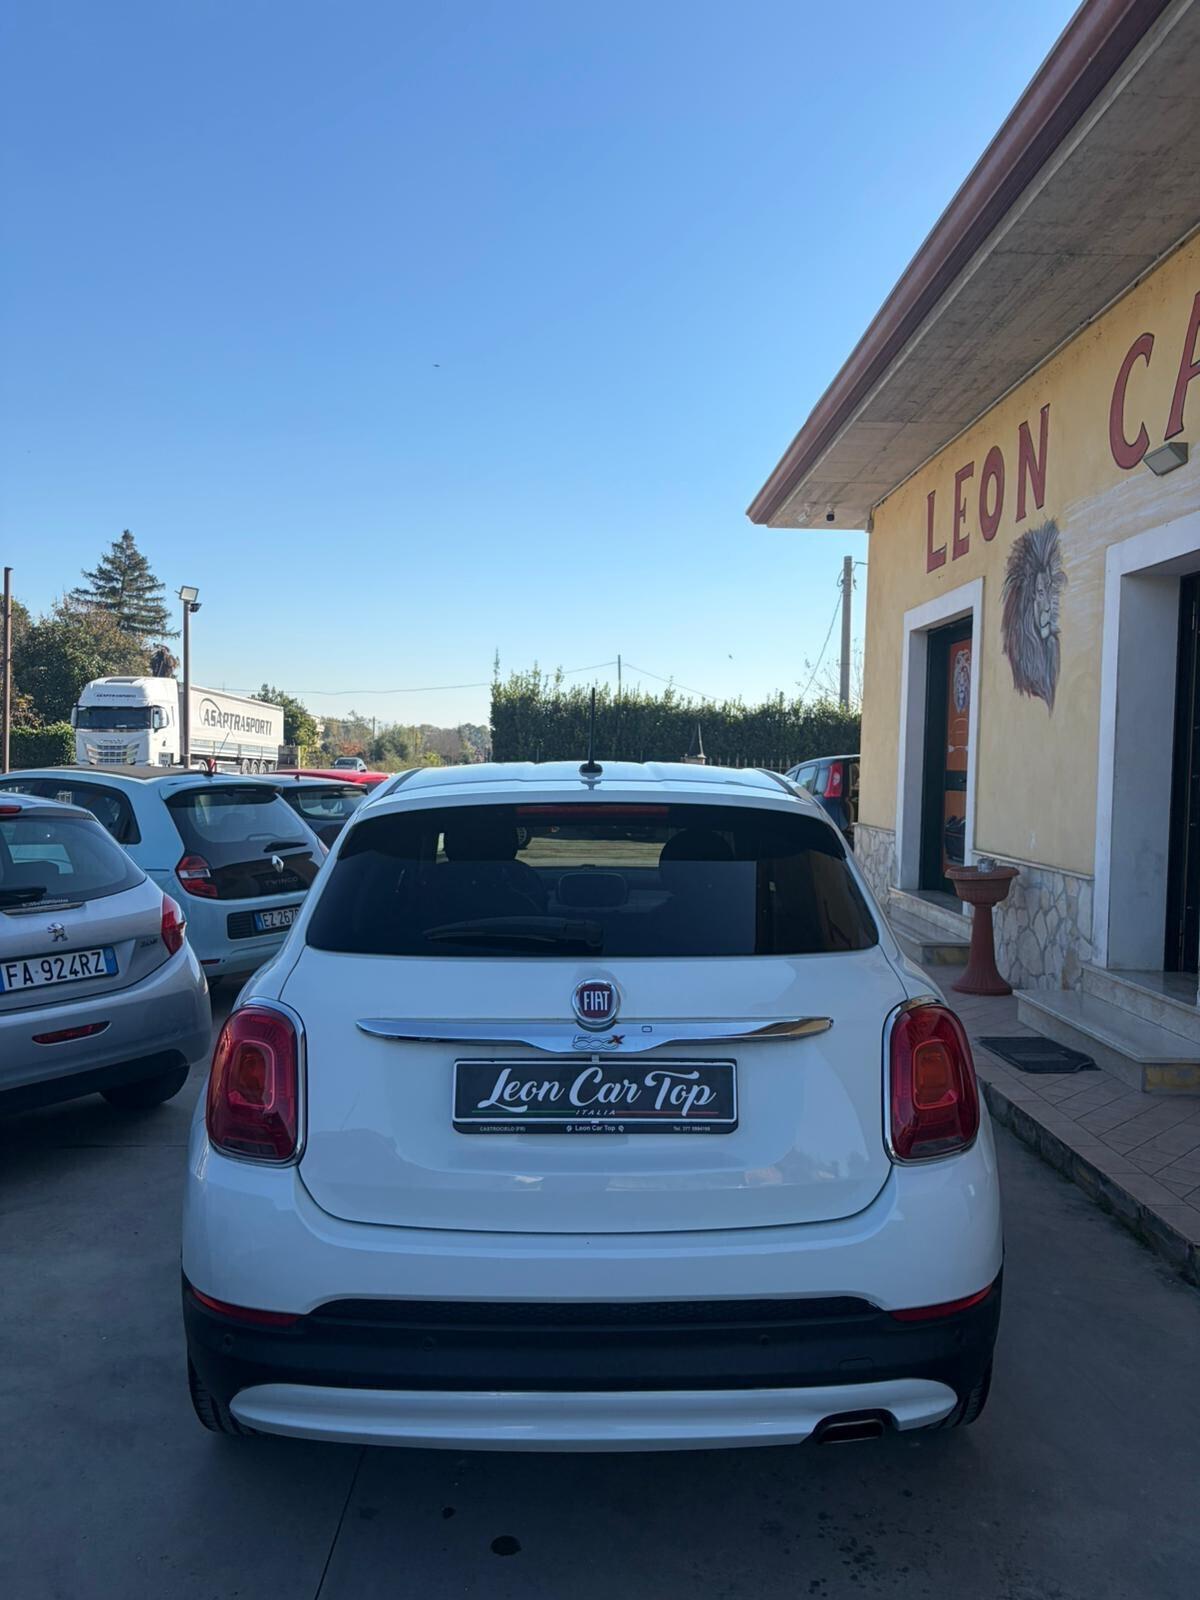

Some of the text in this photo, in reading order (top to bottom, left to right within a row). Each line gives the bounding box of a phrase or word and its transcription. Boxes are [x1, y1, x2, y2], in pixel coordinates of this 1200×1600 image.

[926, 403, 1050, 573] LEON
[203, 708, 272, 736] ASAPTRASPORTI
[262, 911, 276, 927] EZ
[6, 952, 105, 988] FA 924RZ
[583, 990, 610, 1011] FIAT
[477, 1066, 717, 1117] Leon Car Top
